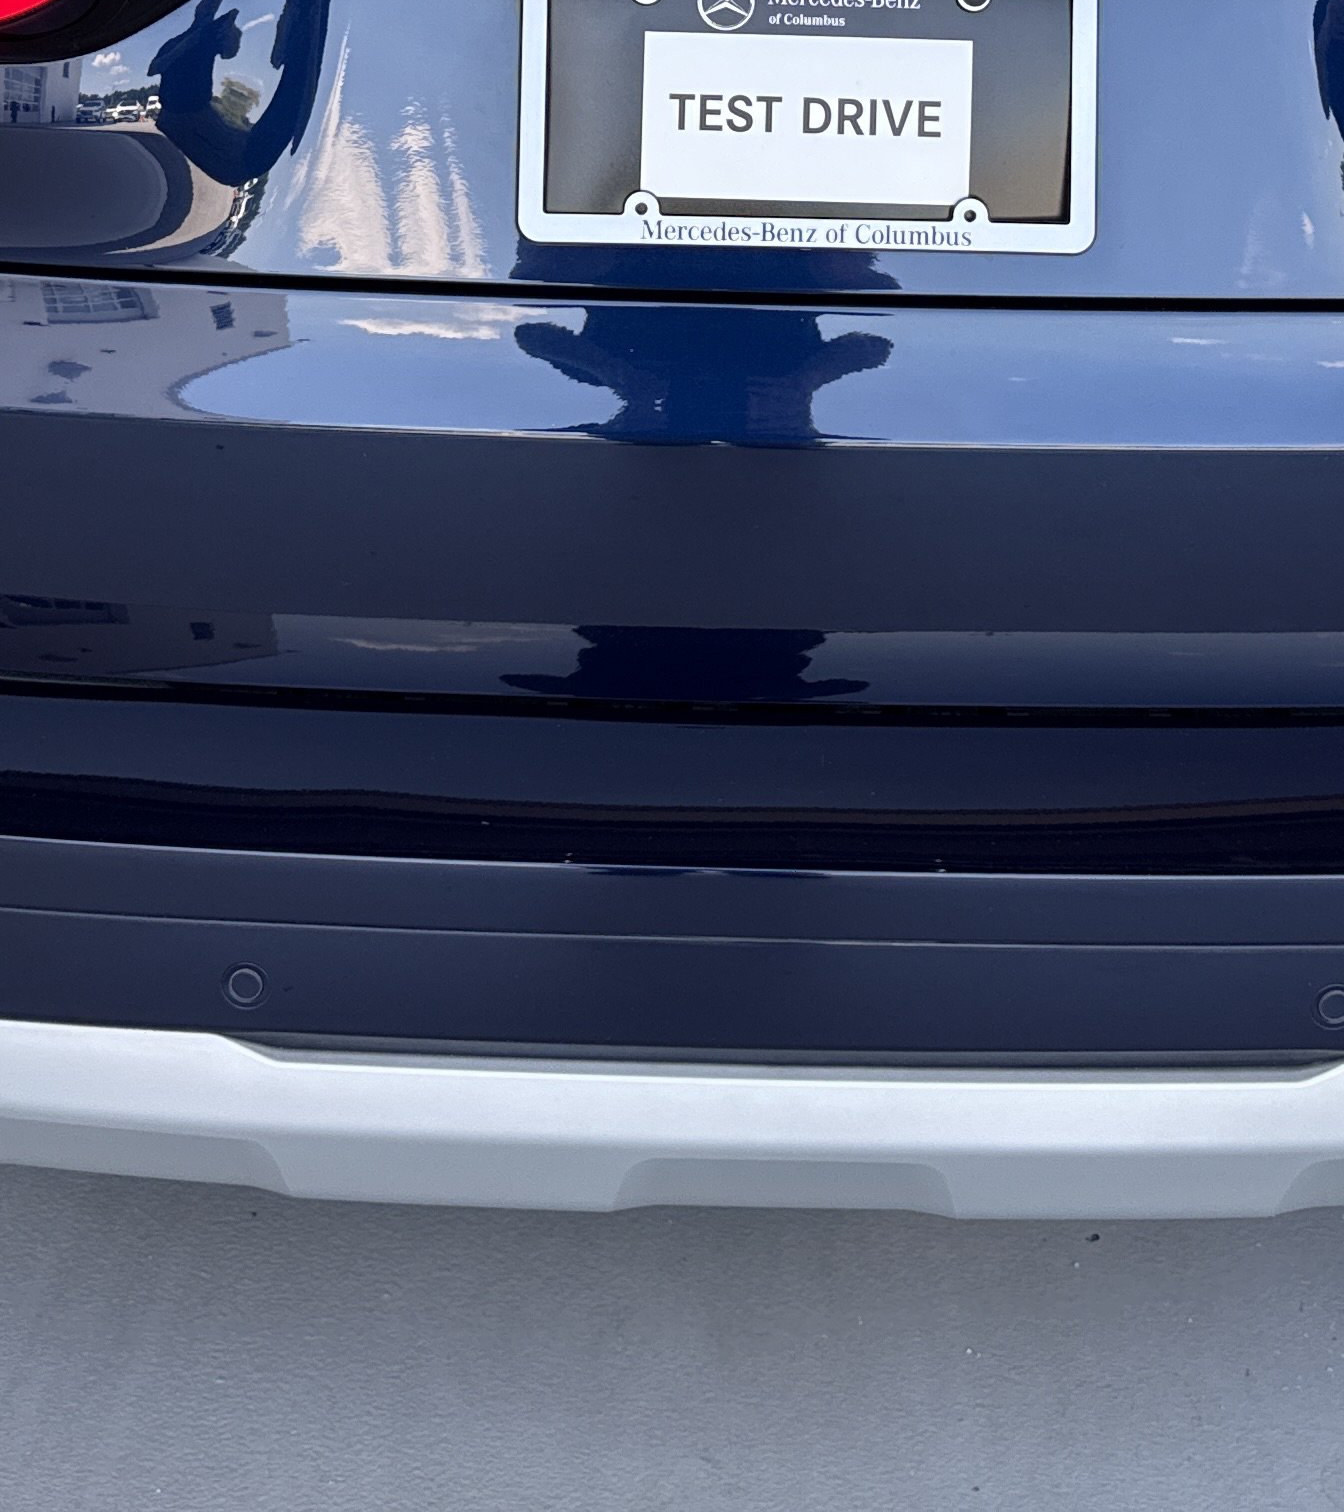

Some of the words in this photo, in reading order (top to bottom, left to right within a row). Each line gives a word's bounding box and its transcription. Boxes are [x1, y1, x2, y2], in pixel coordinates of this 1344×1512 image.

[768, 13, 781, 25] of
[783, 14, 846, 27] Columbus
[669, 93, 783, 133] TEST
[802, 96, 942, 138] DRIVE
[641, 219, 817, 244] Mercedes-Benz
[825, 224, 850, 244] of
[855, 224, 972, 248] Columbus
